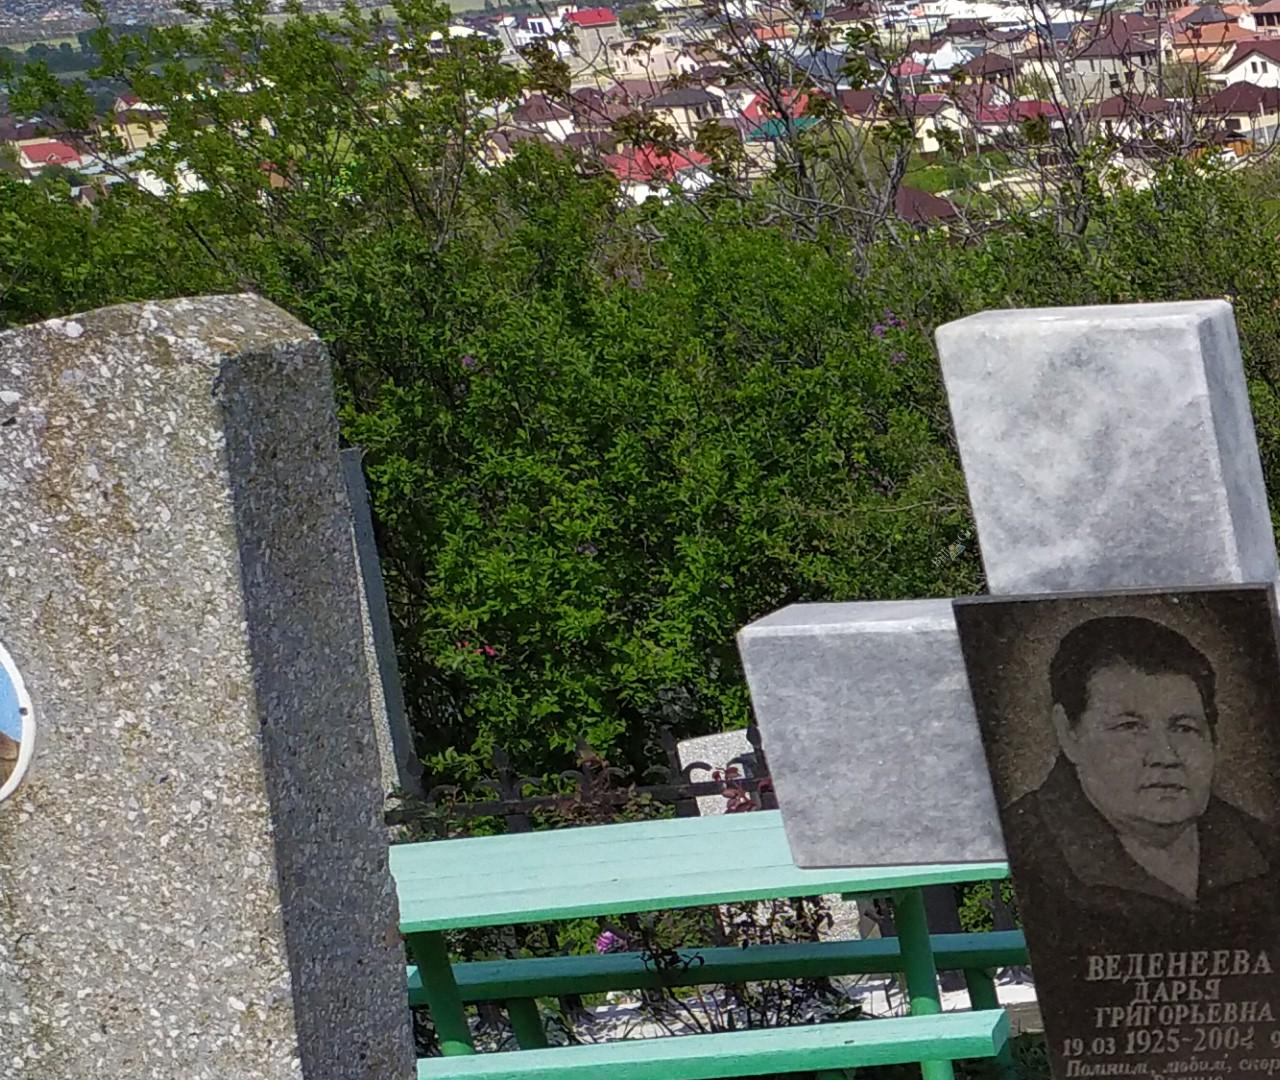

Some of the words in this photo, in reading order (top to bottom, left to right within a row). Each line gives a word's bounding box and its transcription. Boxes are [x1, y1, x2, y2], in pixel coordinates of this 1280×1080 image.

[1085, 949, 1274, 984] ВЕДЕНЕЕВА
[1130, 978, 1222, 1006] ДАРЬЯ
[1095, 1000, 1276, 1029] ГРИГОРЬЕВНА
[1065, 1058, 1157, 1078] Помним,
